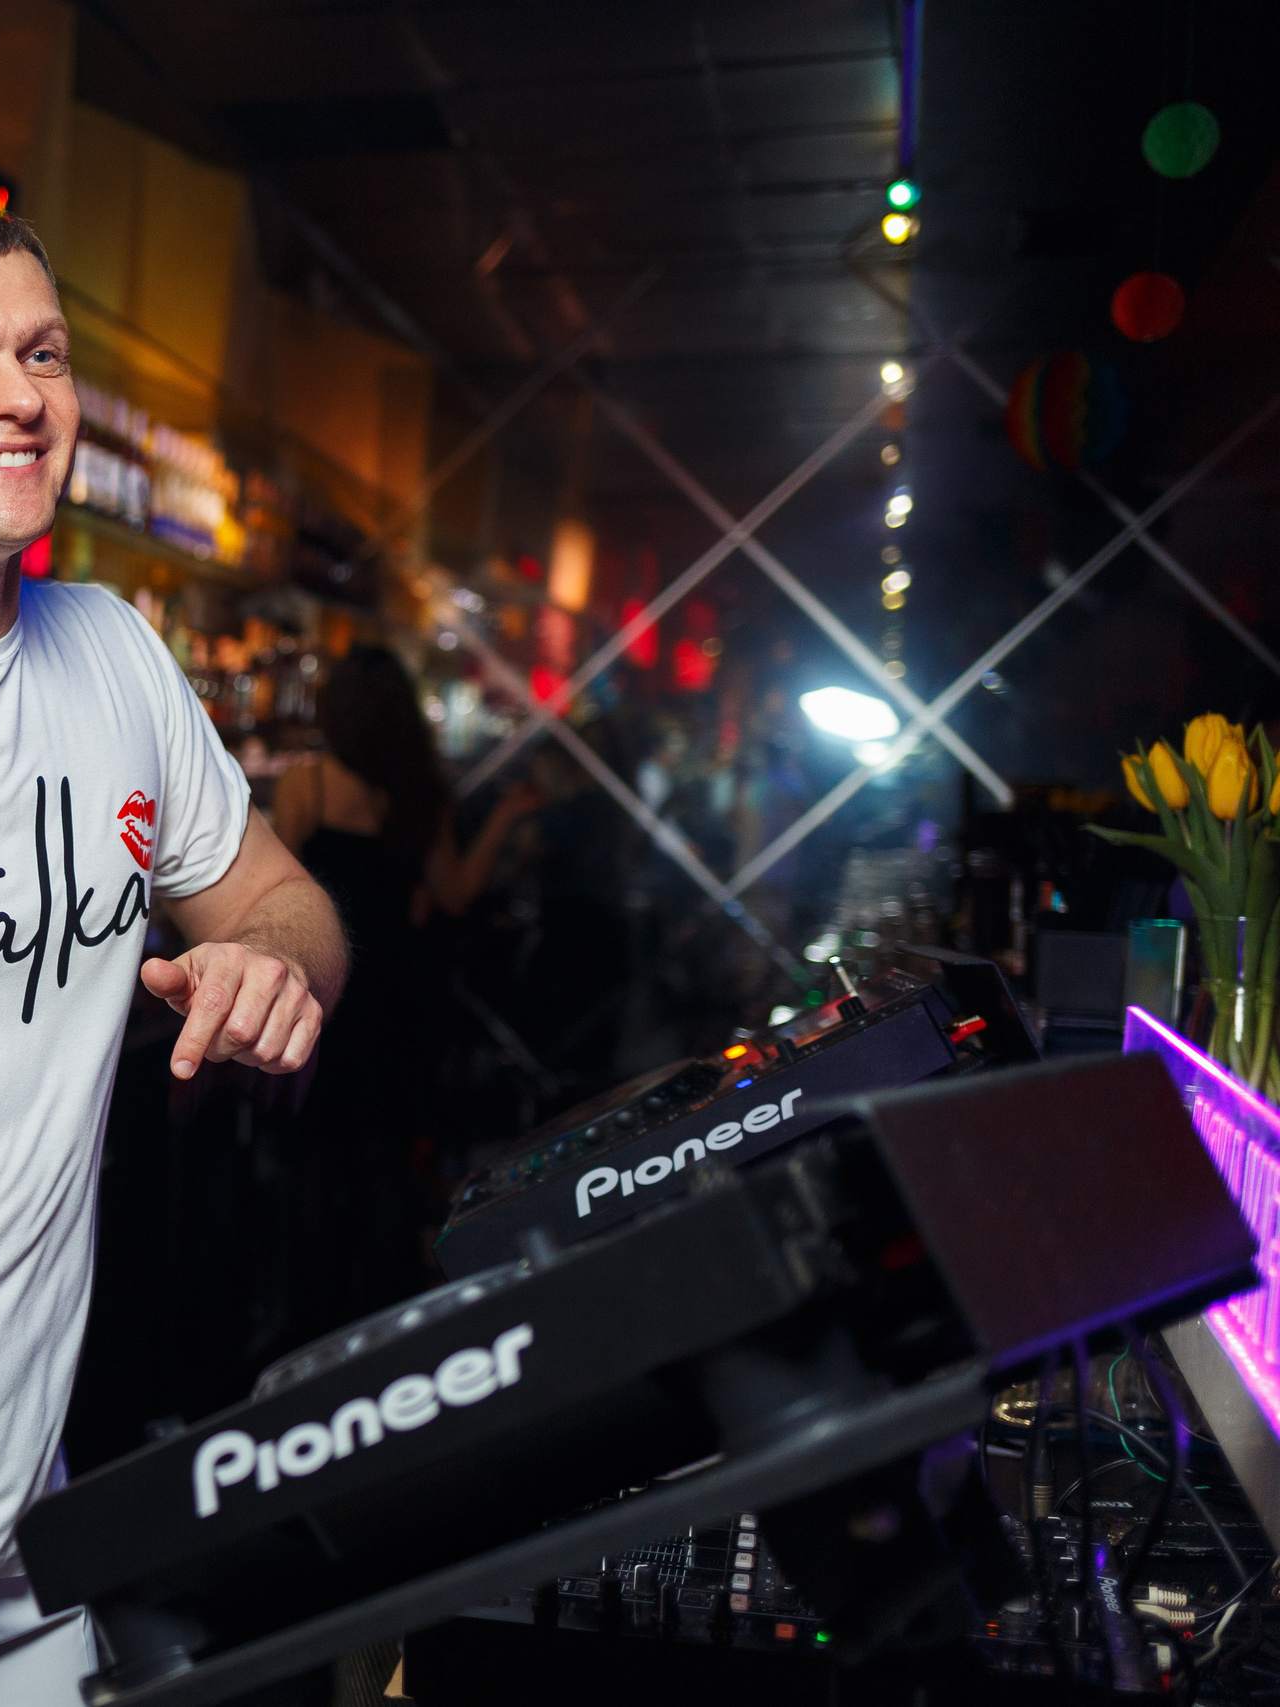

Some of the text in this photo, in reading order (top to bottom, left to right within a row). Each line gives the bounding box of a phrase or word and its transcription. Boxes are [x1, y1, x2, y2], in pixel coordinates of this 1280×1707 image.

[575, 1088, 803, 1219] Pioneer
[192, 1322, 534, 1519] Pioneer
[1096, 1575, 1122, 1615] Pioneer
